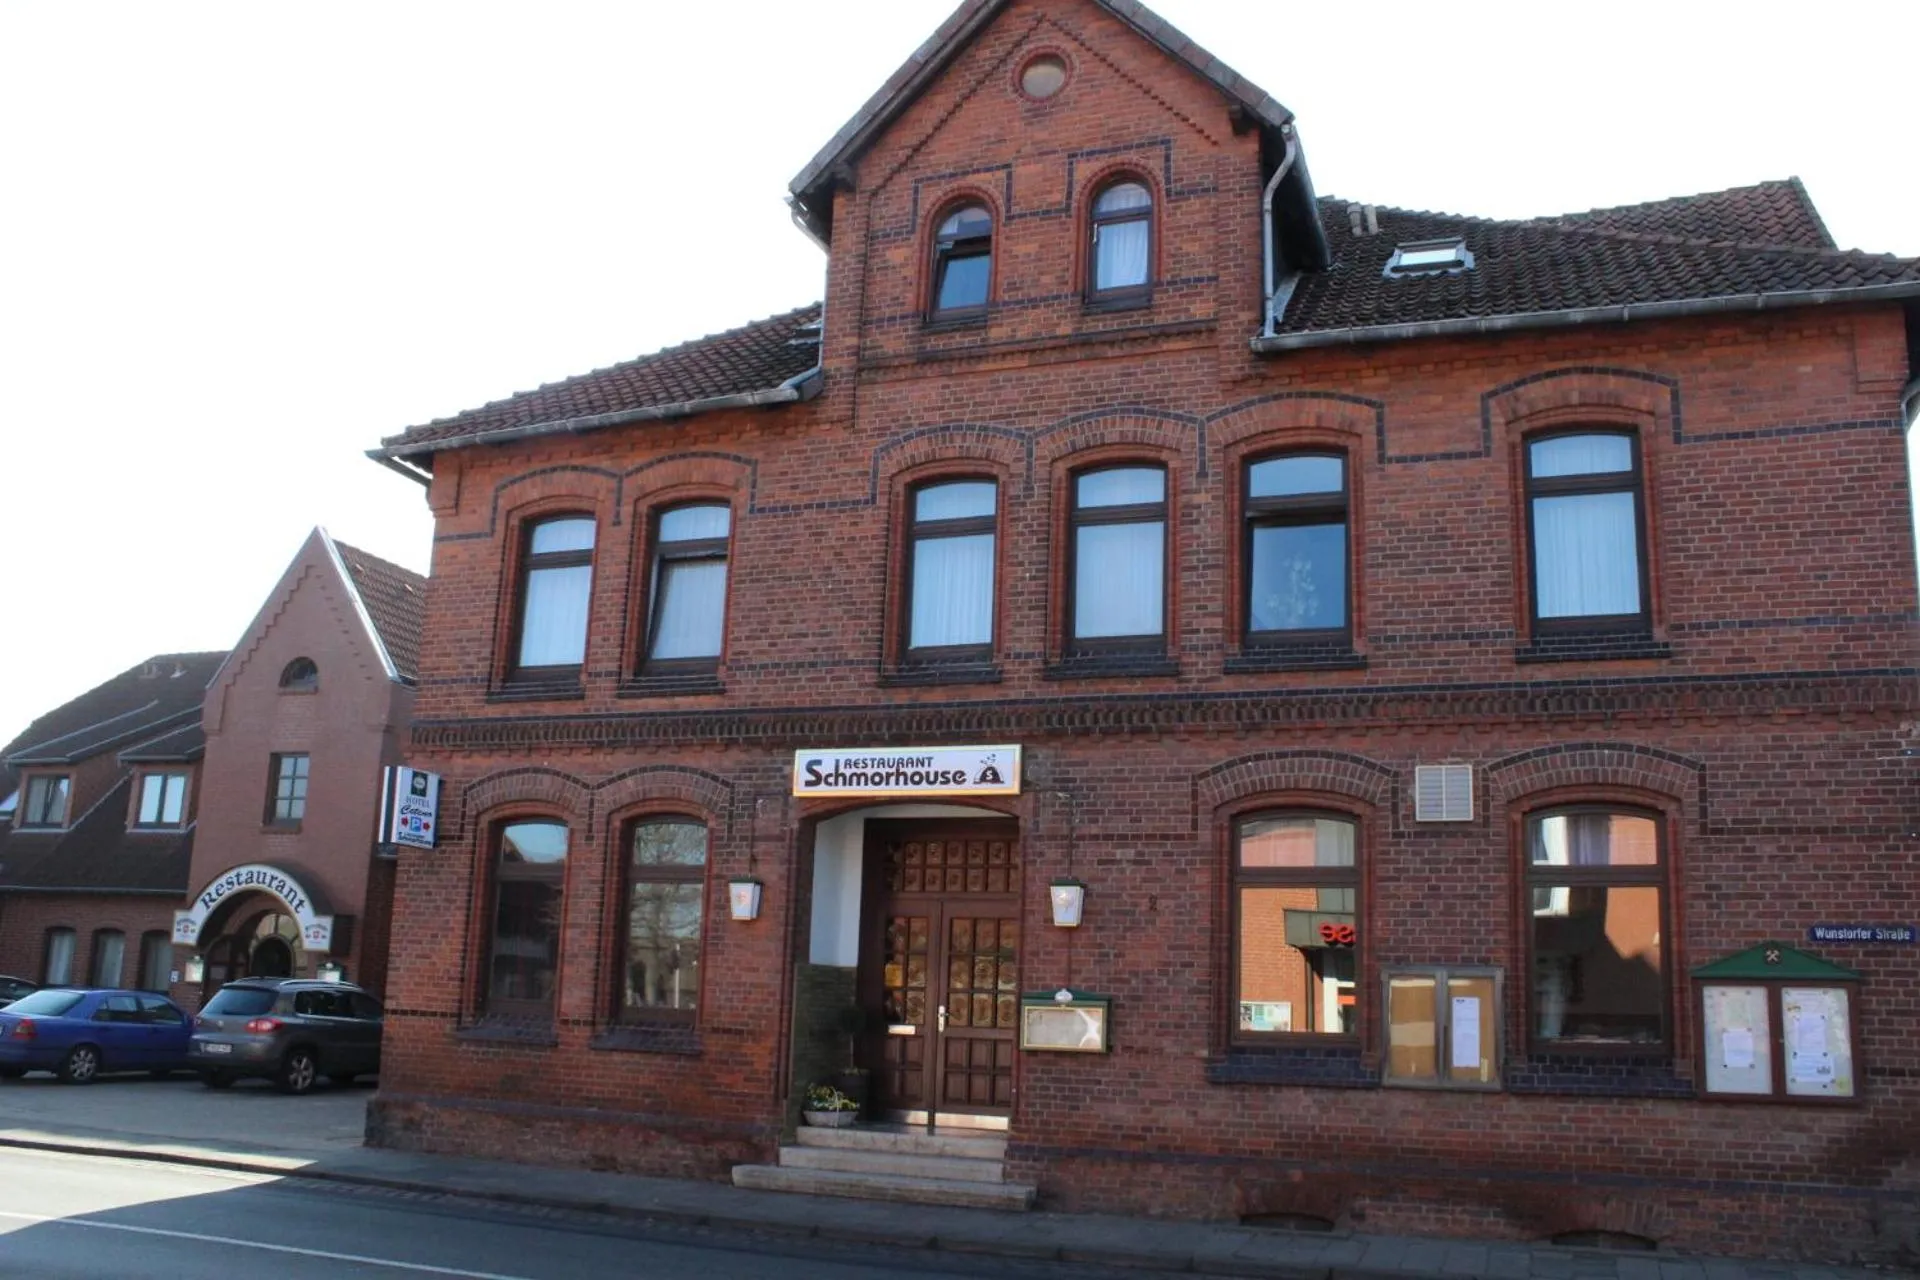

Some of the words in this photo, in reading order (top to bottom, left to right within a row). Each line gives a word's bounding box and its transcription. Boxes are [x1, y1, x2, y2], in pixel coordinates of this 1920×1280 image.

[804, 758, 967, 787] Schmorhouse
[843, 756, 934, 769] RESTAURANT
[201, 869, 305, 914] Restaurant
[1815, 926, 1872, 940] Wunstorfer
[1876, 927, 1911, 941] Straße
